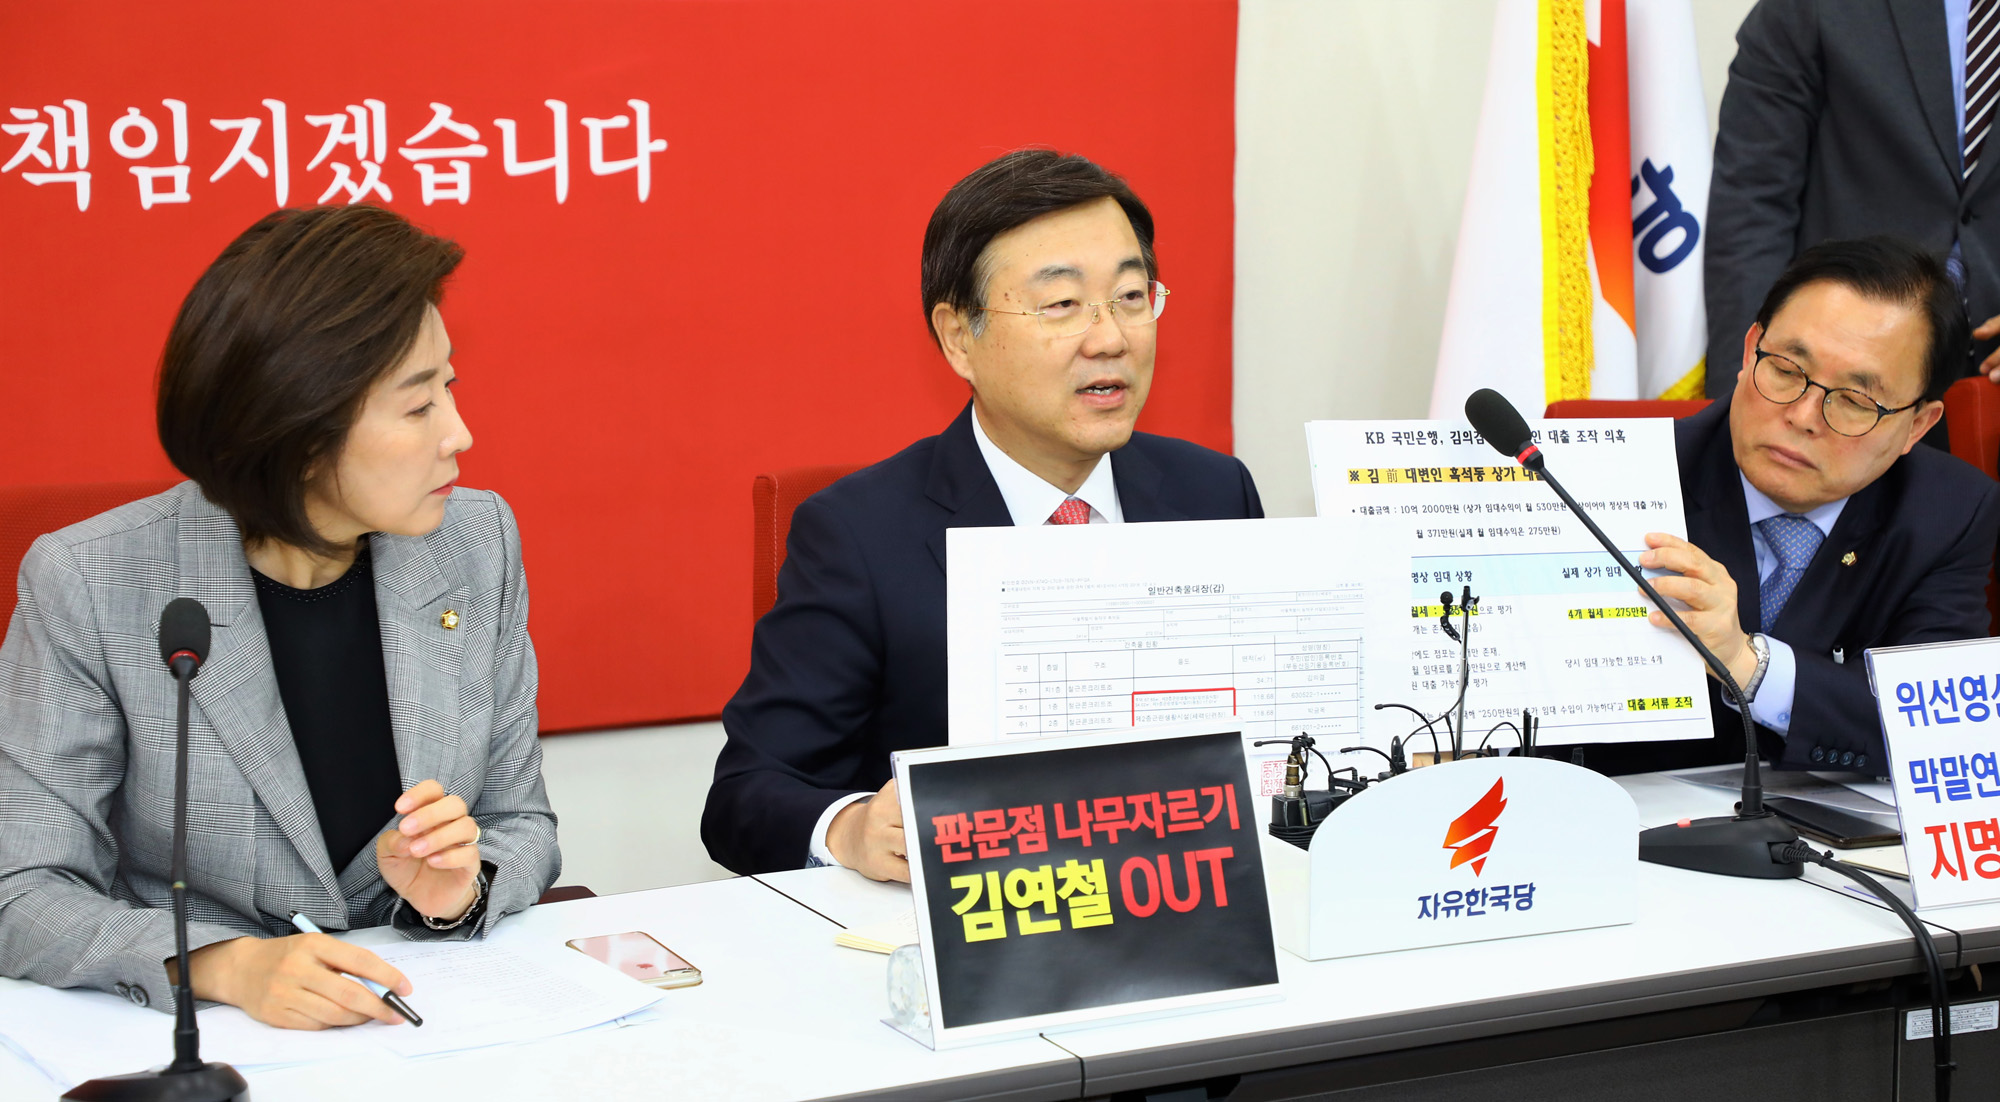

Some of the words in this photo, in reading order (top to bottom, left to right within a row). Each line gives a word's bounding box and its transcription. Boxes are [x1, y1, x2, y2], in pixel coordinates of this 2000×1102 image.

[1, 98, 668, 212] 책임지겠습니다
[1364, 431, 1385, 445] KB
[1391, 430, 1444, 445] 국민은행,
[1548, 430, 1570, 444] 대출
[1576, 430, 1598, 444] 조작
[1604, 429, 1626, 444] 의혹
[1367, 468, 1379, 484] 김
[1405, 468, 1443, 483] 대변인
[1492, 466, 1516, 482] 상가
[1360, 506, 1390, 516] 대출금액
[1400, 505, 1418, 515] 10억
[1422, 504, 1460, 514] 2000만원
[1463, 503, 1482, 514] (상가
[1485, 503, 1522, 513] 임대수익이
[1609, 501, 1630, 511] 정상적
[1650, 500, 1668, 510] 가능)
[1488, 527, 1525, 537] 임대수익은
[1528, 526, 1561, 536] 275만원)
[1433, 571, 1451, 583] 임대
[1455, 570, 1473, 583] 상황
[1562, 566, 1580, 579] 실제
[1584, 566, 1602, 578] 상가
[1605, 566, 1622, 577] 임대
[1147, 583, 1225, 596] 일반건축물대장(갑)
[1497, 604, 1513, 615] 평가
[1568, 608, 1583, 620] 4개
[1587, 608, 1604, 619] 월세
[1615, 606, 1648, 618] 275만원
[1565, 658, 1581, 669] 당시
[1584, 658, 1599, 668] 임대
[1601, 656, 1623, 667] 가능한
[1651, 655, 1663, 665] 4개
[1473, 678, 1488, 688] 평가
[1542, 706, 1557, 716] 임대
[1627, 699, 1646, 711] 대출
[1651, 698, 1669, 710] 서류
[1675, 696, 1693, 708] 조작
[931, 804, 1049, 863] 판문점
[1053, 783, 1241, 848] 나무자르기
[950, 858, 1114, 943] 김연철
[1119, 846, 1235, 918] OUT
[1417, 882, 1537, 921] 자유한국당
